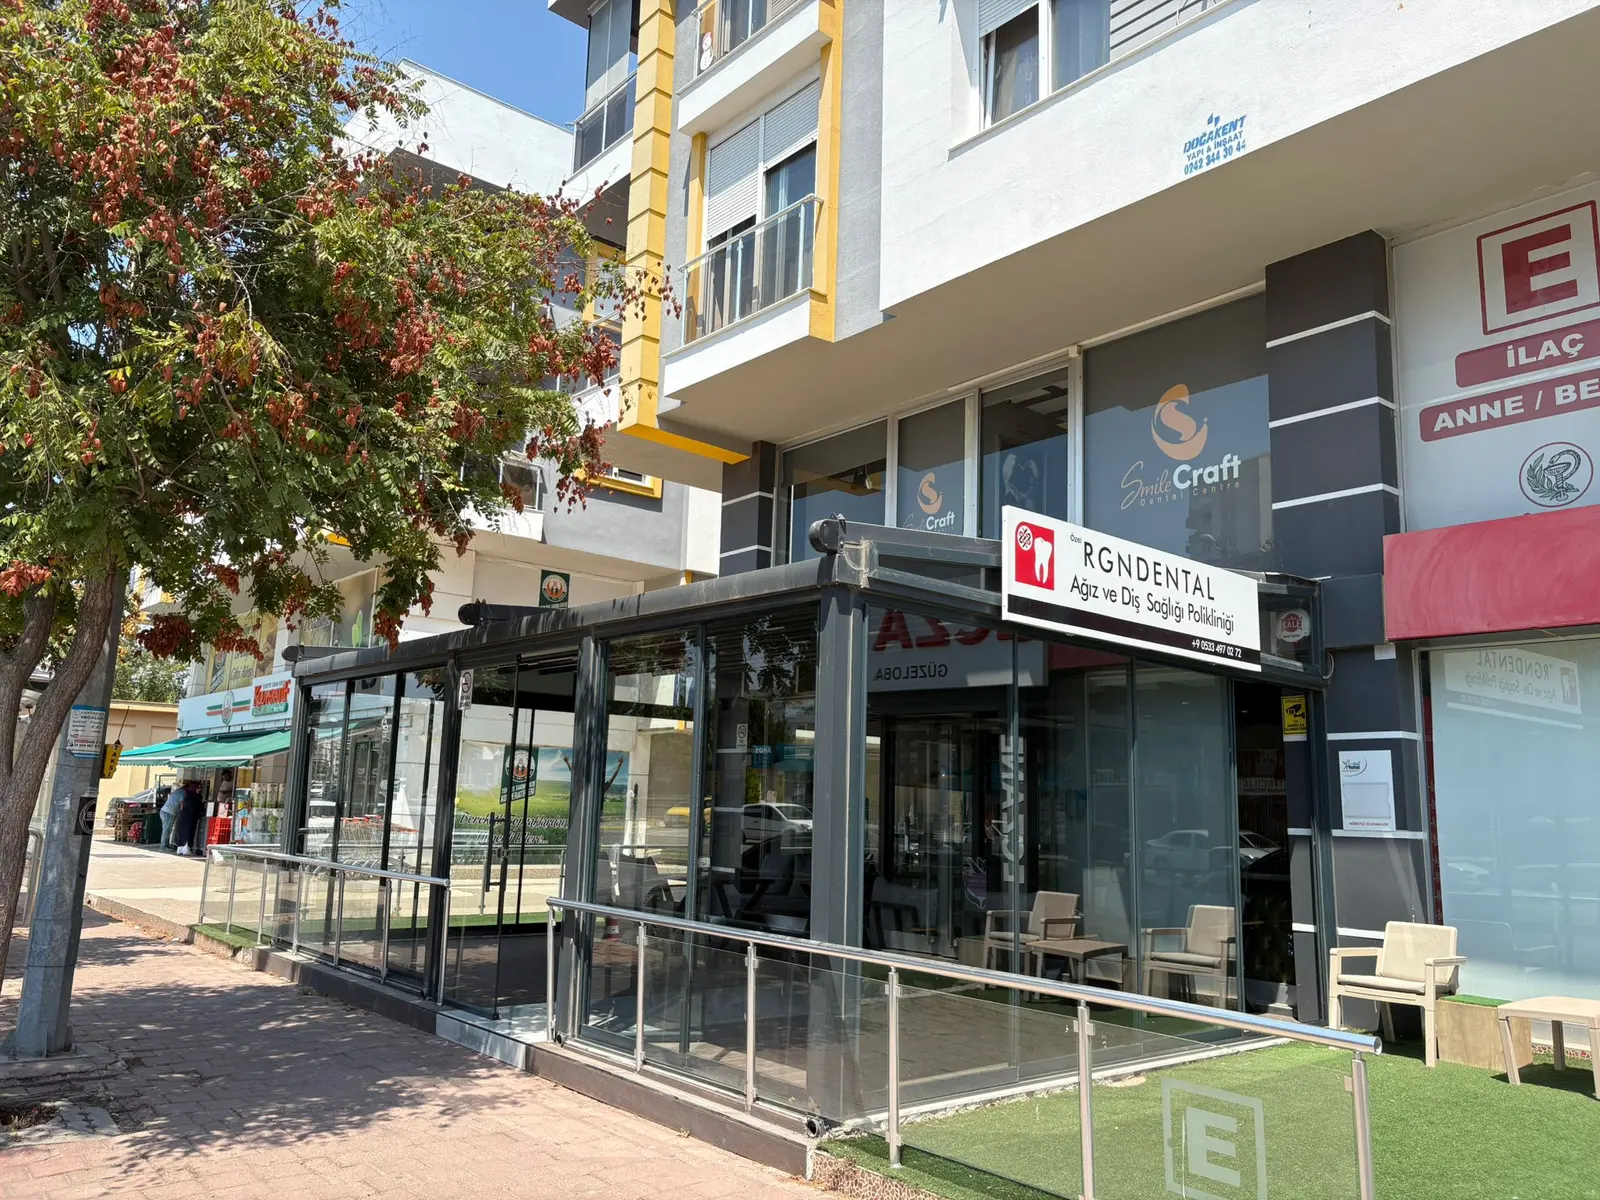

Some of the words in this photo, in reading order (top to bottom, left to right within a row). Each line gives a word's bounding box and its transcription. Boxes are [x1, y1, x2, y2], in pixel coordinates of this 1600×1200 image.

[1183, 114, 1247, 154] DOĞAKENT
[1187, 148, 1204, 161] YAPI
[1214, 130, 1243, 149] İNŞAAT
[1184, 158, 1203, 175] 0242
[1206, 150, 1220, 166] 344
[1223, 145, 1233, 158] 30
[1501, 223, 1578, 315] E
[1506, 333, 1585, 369] İLAÇ
[1433, 394, 1524, 432] ANNE
[1173, 453, 1241, 489] Craft
[1140, 491, 1183, 507] Dental
[1193, 481, 1240, 496] Centre
[925, 511, 956, 530] Craft
[1083, 541, 1215, 601] RGNDENTAL
[1070, 574, 1098, 602] Ağız
[1103, 588, 1117, 603] ve
[1121, 586, 1141, 613] Diş
[1147, 592, 1184, 623] Sağlığı
[1187, 603, 1235, 636] Polikliniği
[1191, 639, 1200, 651] +9
[1200, 640, 1215, 653] 0533
[1216, 642, 1226, 655] 497
[1227, 646, 1235, 657] 02
[1234, 647, 1242, 659] 72
[1186, 1106, 1241, 1187] E
